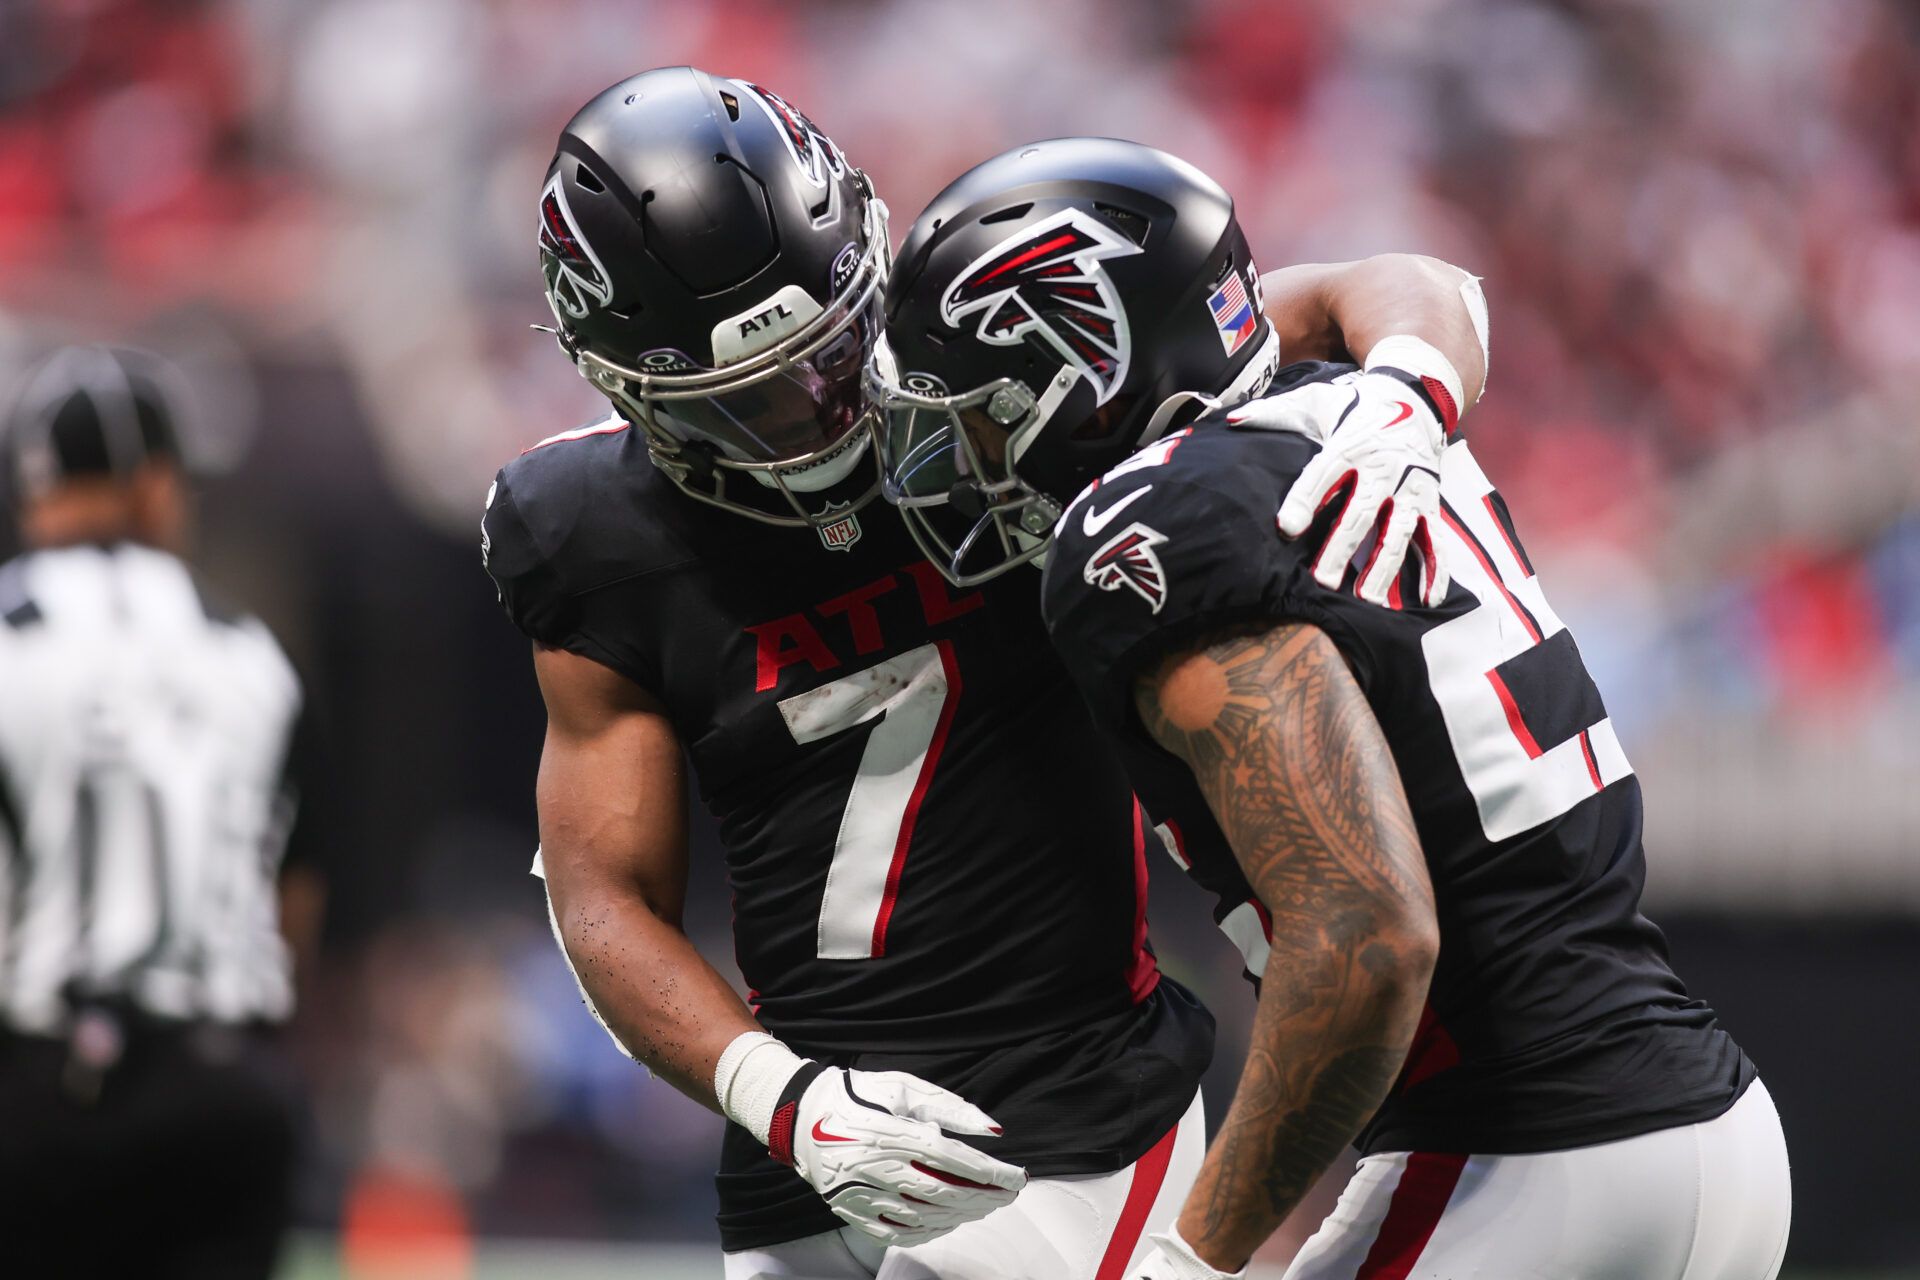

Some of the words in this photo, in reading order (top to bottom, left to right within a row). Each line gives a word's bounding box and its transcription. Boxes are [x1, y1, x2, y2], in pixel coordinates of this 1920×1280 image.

[738, 303, 793, 339] ATL
[823, 520, 856, 544] NFL
[744, 558, 986, 693] ATL
[776, 639, 963, 960] 7
